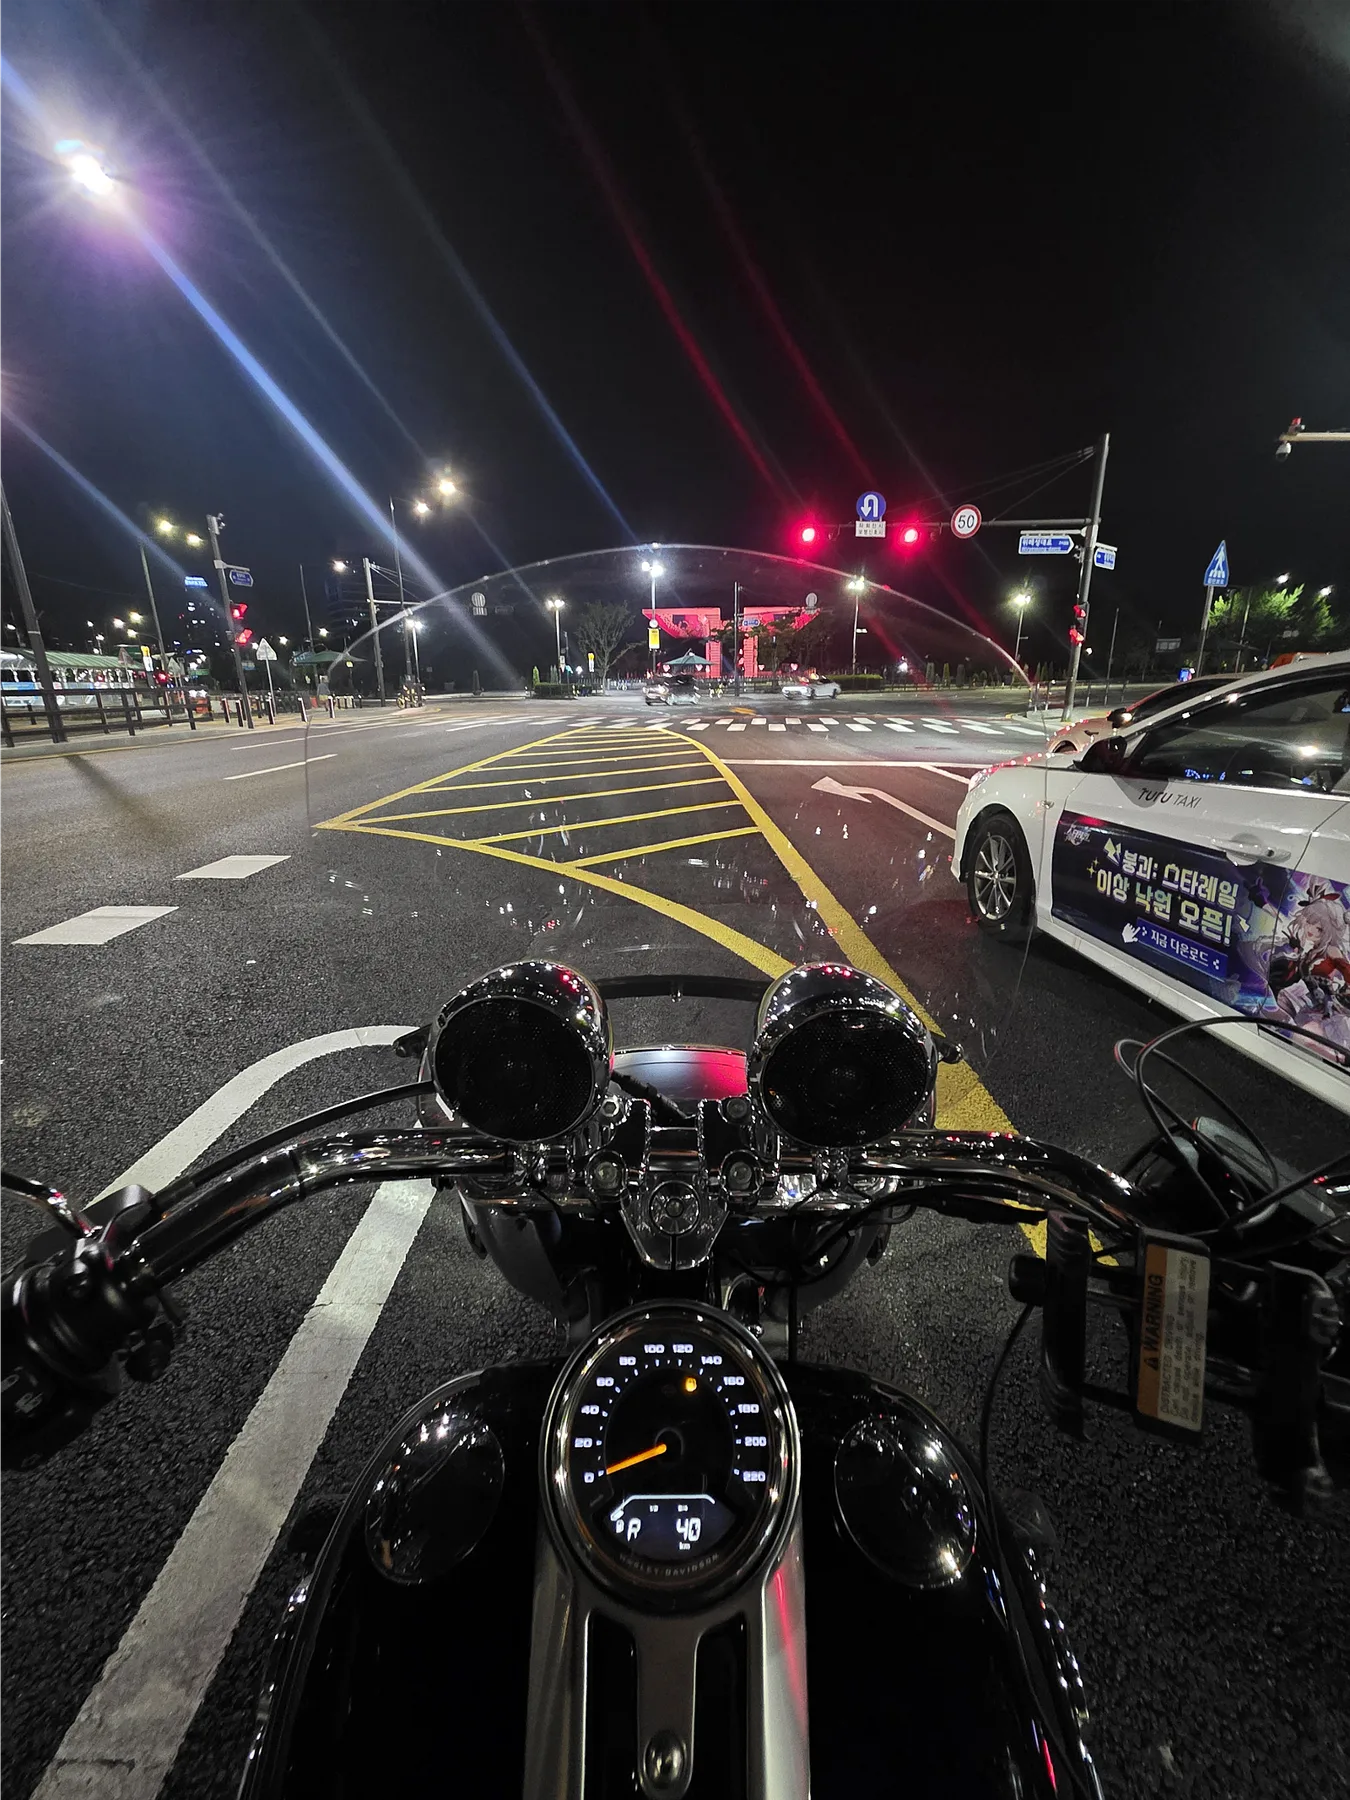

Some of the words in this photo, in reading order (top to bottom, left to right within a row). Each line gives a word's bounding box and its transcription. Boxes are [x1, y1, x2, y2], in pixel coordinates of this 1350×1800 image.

[957, 514, 975, 529] 50
[1173, 793, 1203, 809] TAXI
[1122, 849, 1159, 881] 붕괴:
[1162, 862, 1239, 910] 스타레일
[1096, 868, 1131, 902] 이상
[1134, 881, 1173, 921] 낙원
[1178, 899, 1233, 946] 오픈!
[1150, 928, 1168, 950] 지금
[1170, 937, 1209, 967] 다운로드
[1142, 1274, 1164, 1352] WARNING
[644, 1344, 665, 1353] 100
[672, 1344, 694, 1353] 120
[701, 1355, 723, 1365] 140
[581, 1404, 600, 1415] 40
[574, 1437, 593, 1448] 20
[744, 1436, 767, 1447] 200
[584, 1472, 595, 1483] 0
[743, 1471, 766, 1482] 220
[675, 1517, 701, 1542] 40
[679, 1541, 691, 1550] km
